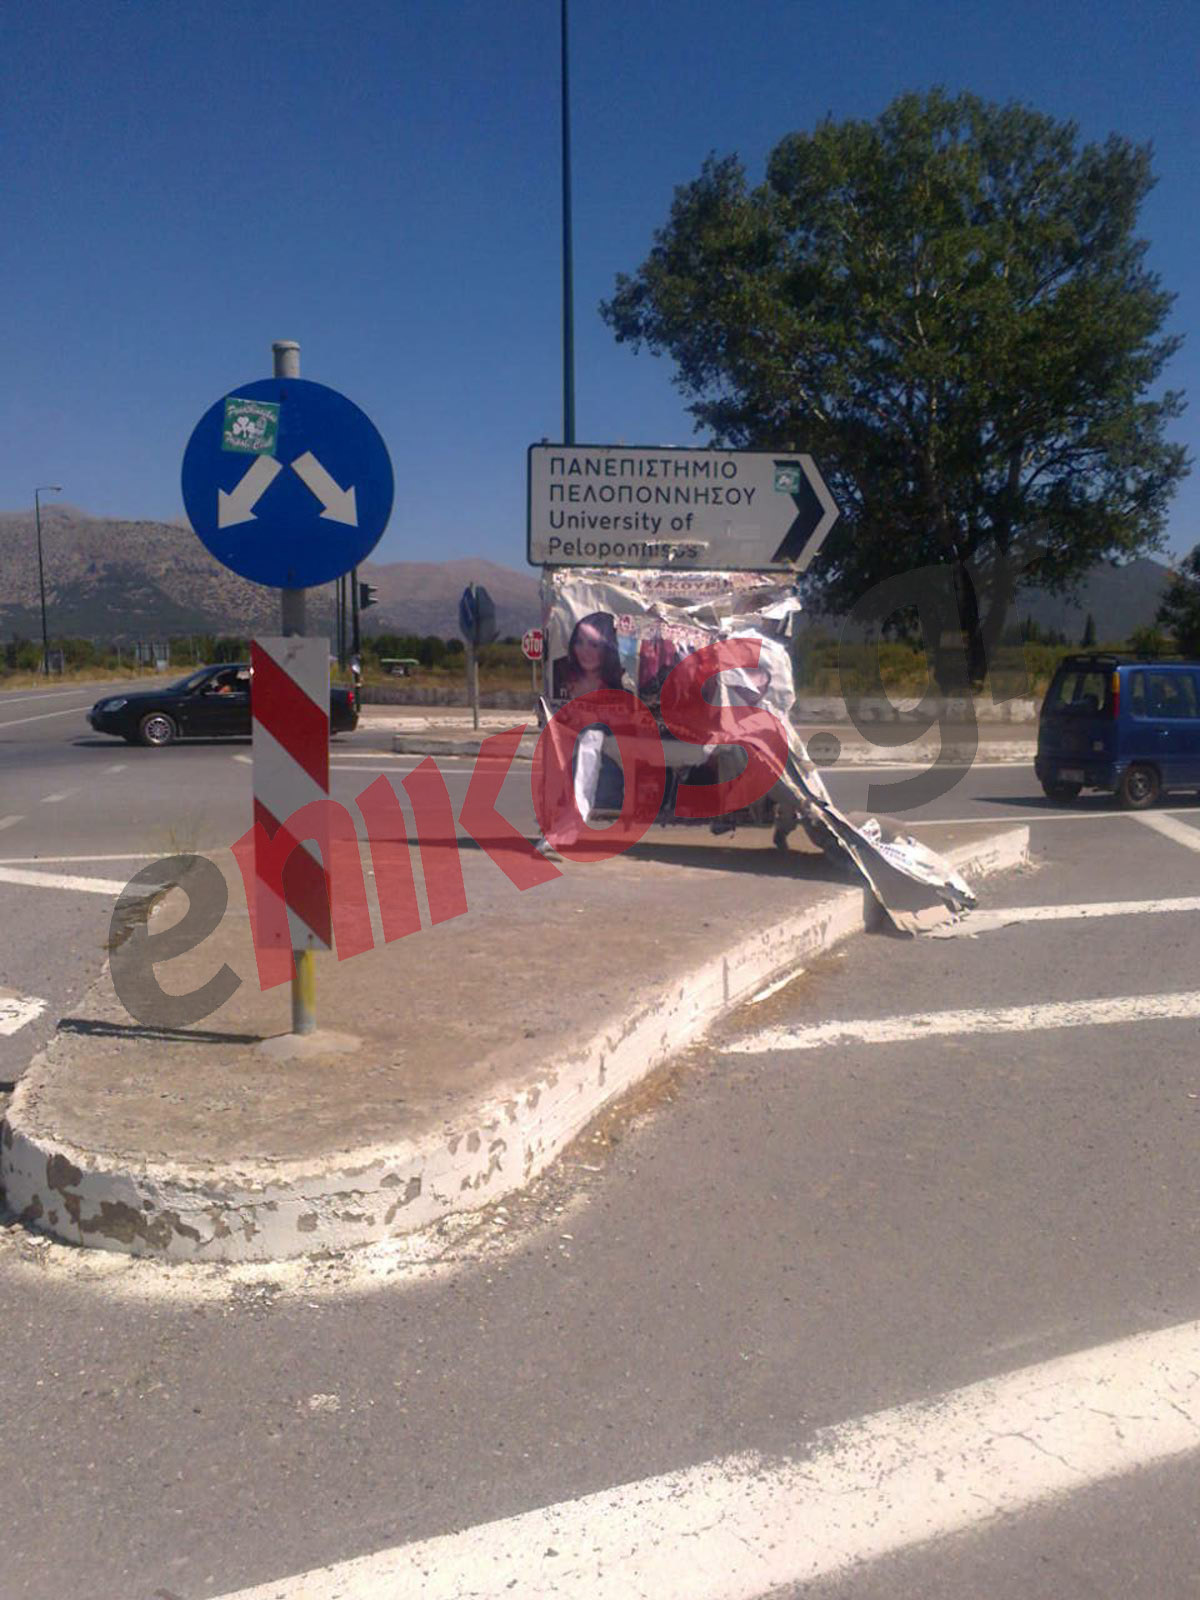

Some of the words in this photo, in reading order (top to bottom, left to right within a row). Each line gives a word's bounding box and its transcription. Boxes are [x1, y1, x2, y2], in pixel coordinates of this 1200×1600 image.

[550, 456, 738, 480] ΠΑΝΕΠΙΣΤΗΜΙΟ
[550, 484, 757, 506] ΠΕΛΟΠΟΝΝΗΣΟΥ
[549, 510, 661, 534] University
[670, 512, 694, 531] of
